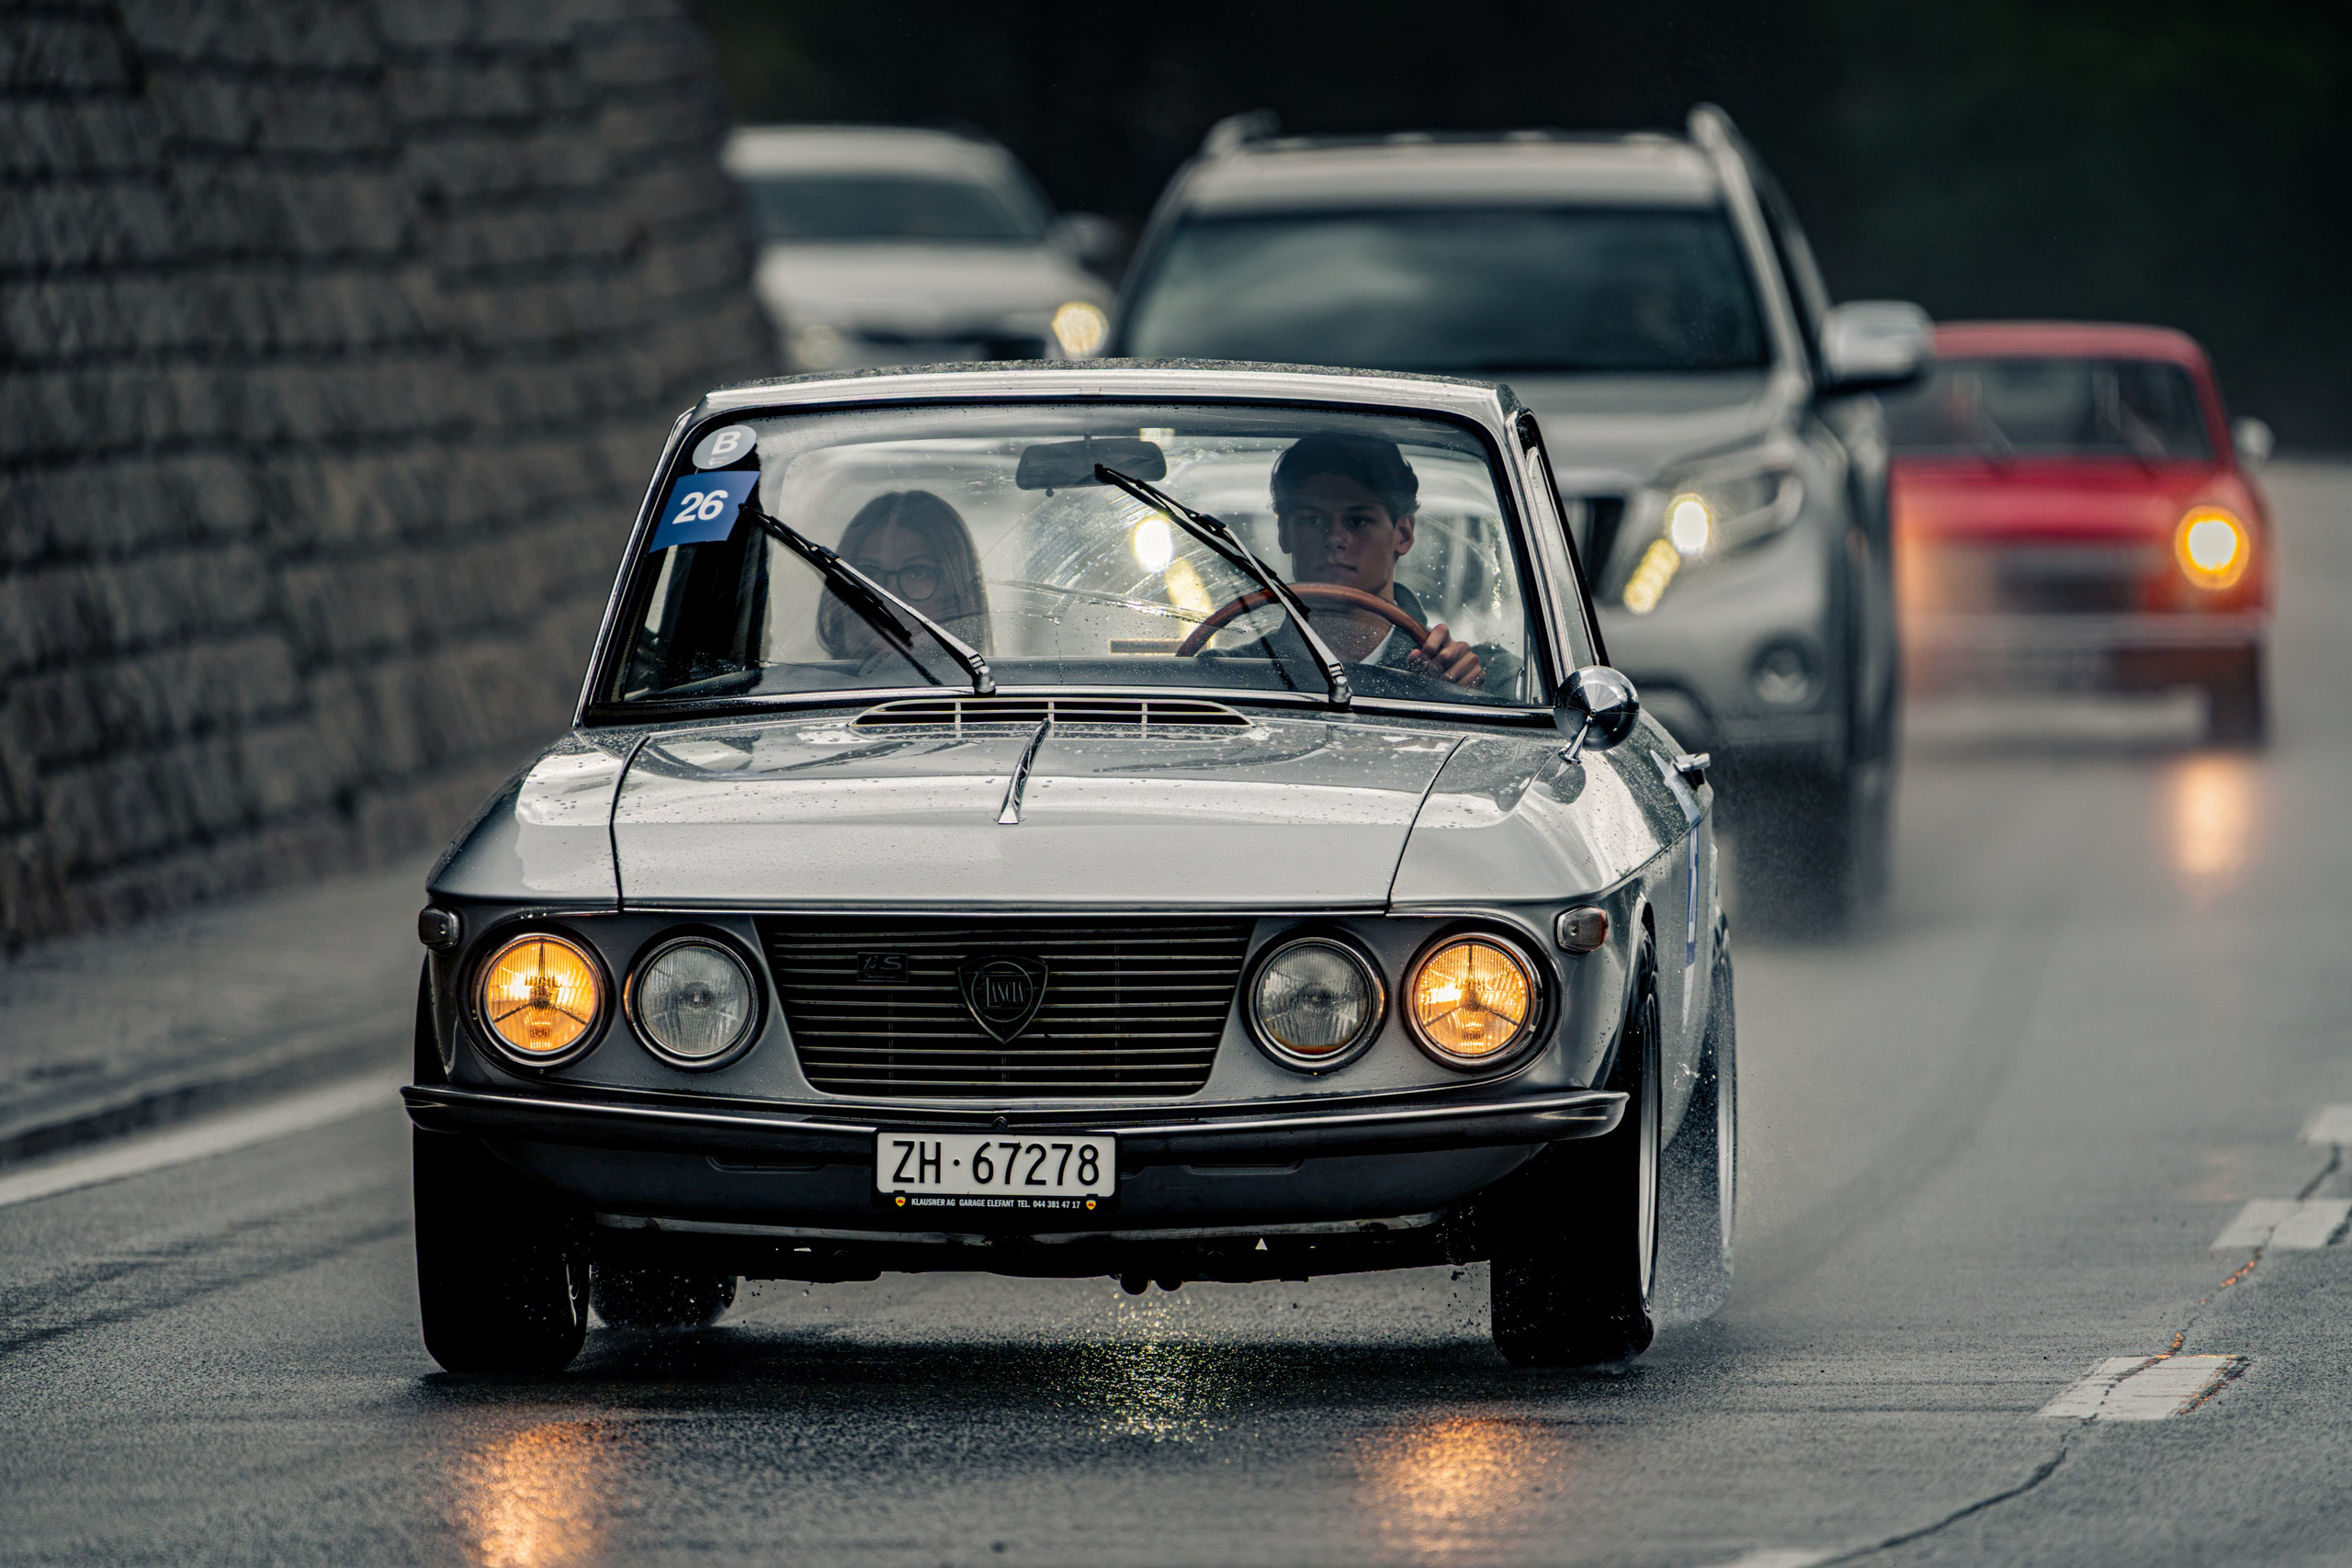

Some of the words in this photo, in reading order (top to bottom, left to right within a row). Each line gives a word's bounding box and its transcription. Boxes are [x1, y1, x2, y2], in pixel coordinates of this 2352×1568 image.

[711, 431, 741, 456] B
[672, 490, 729, 525] 26
[985, 976, 1024, 1008] LANCIA
[892, 1140, 942, 1184] ZH
[972, 1140, 1100, 1186] 67278
[911, 1198, 945, 1206] KLAUSNER
[946, 1198, 956, 1207] AG
[959, 1199, 986, 1207] GARAGE
[987, 1199, 1015, 1207] ELEFANT
[1017, 1200, 1031, 1208] TEL.
[1033, 1200, 1046, 1208] 044
[1047, 1200, 1060, 1209] 381
[1061, 1201, 1070, 1209] 47
[1071, 1201, 1080, 1209] 17
